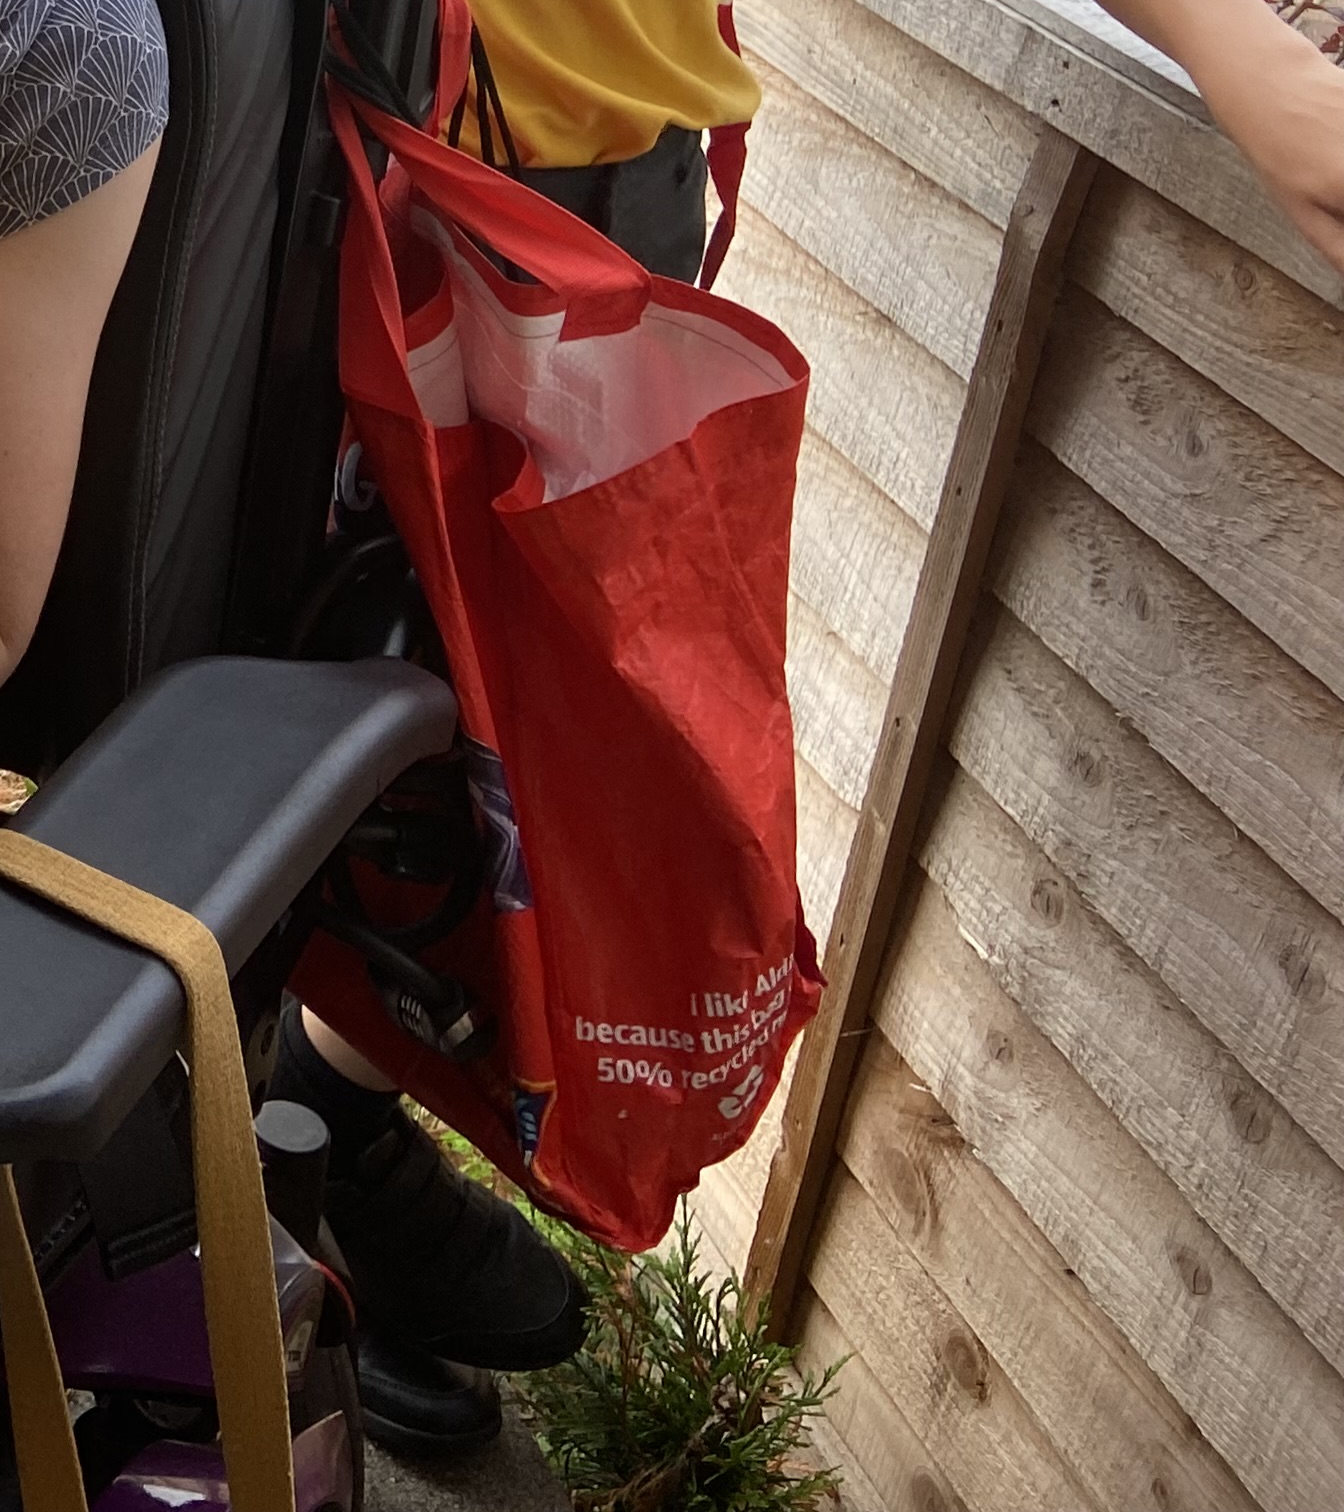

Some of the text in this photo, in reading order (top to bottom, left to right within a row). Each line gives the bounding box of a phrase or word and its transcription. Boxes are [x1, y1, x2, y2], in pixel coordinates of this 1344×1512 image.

[754, 952, 795, 997] Aldi
[575, 1016, 696, 1053] because
[700, 1022, 751, 1054] this
[597, 1057, 673, 1088] 50%
